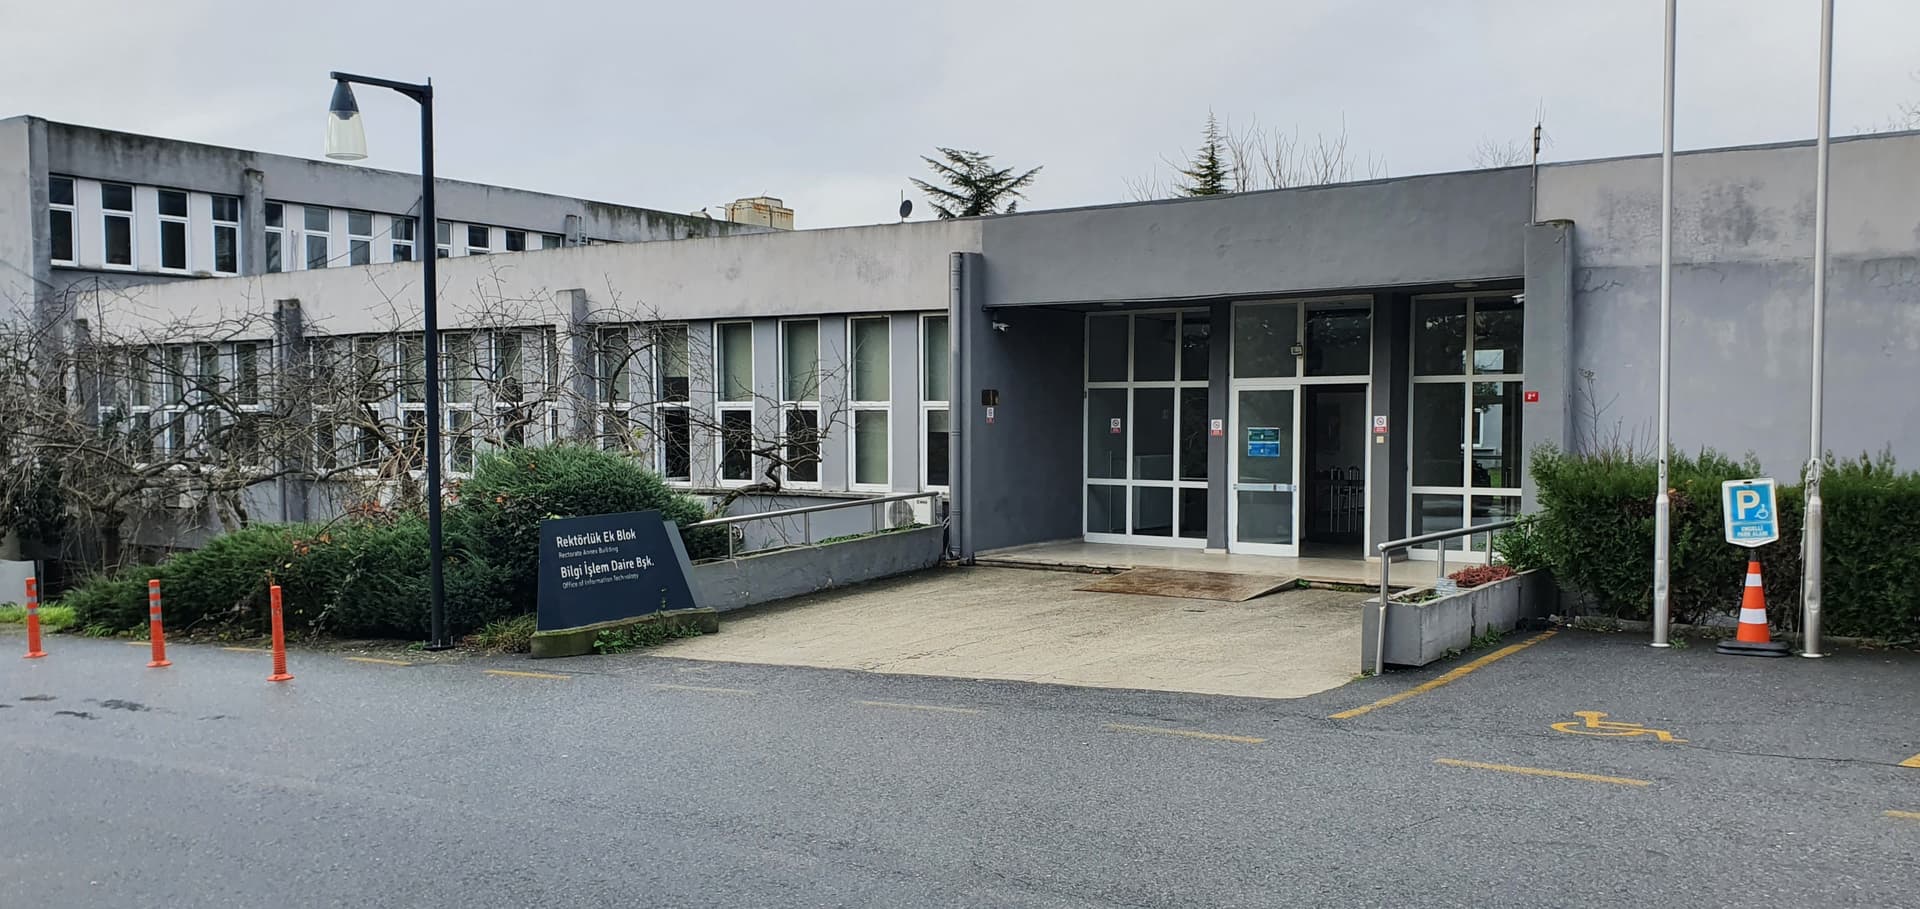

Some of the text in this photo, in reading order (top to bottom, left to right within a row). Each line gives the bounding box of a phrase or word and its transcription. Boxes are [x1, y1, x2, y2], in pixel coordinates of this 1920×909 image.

[1736, 490, 1760, 520] P
[556, 528, 637, 548] Rektörlük Ek Blok
[558, 550, 582, 558] Rectorate
[560, 555, 655, 580] Bilgi İşlem Daire Bşk.
[562, 581, 578, 589] Office
